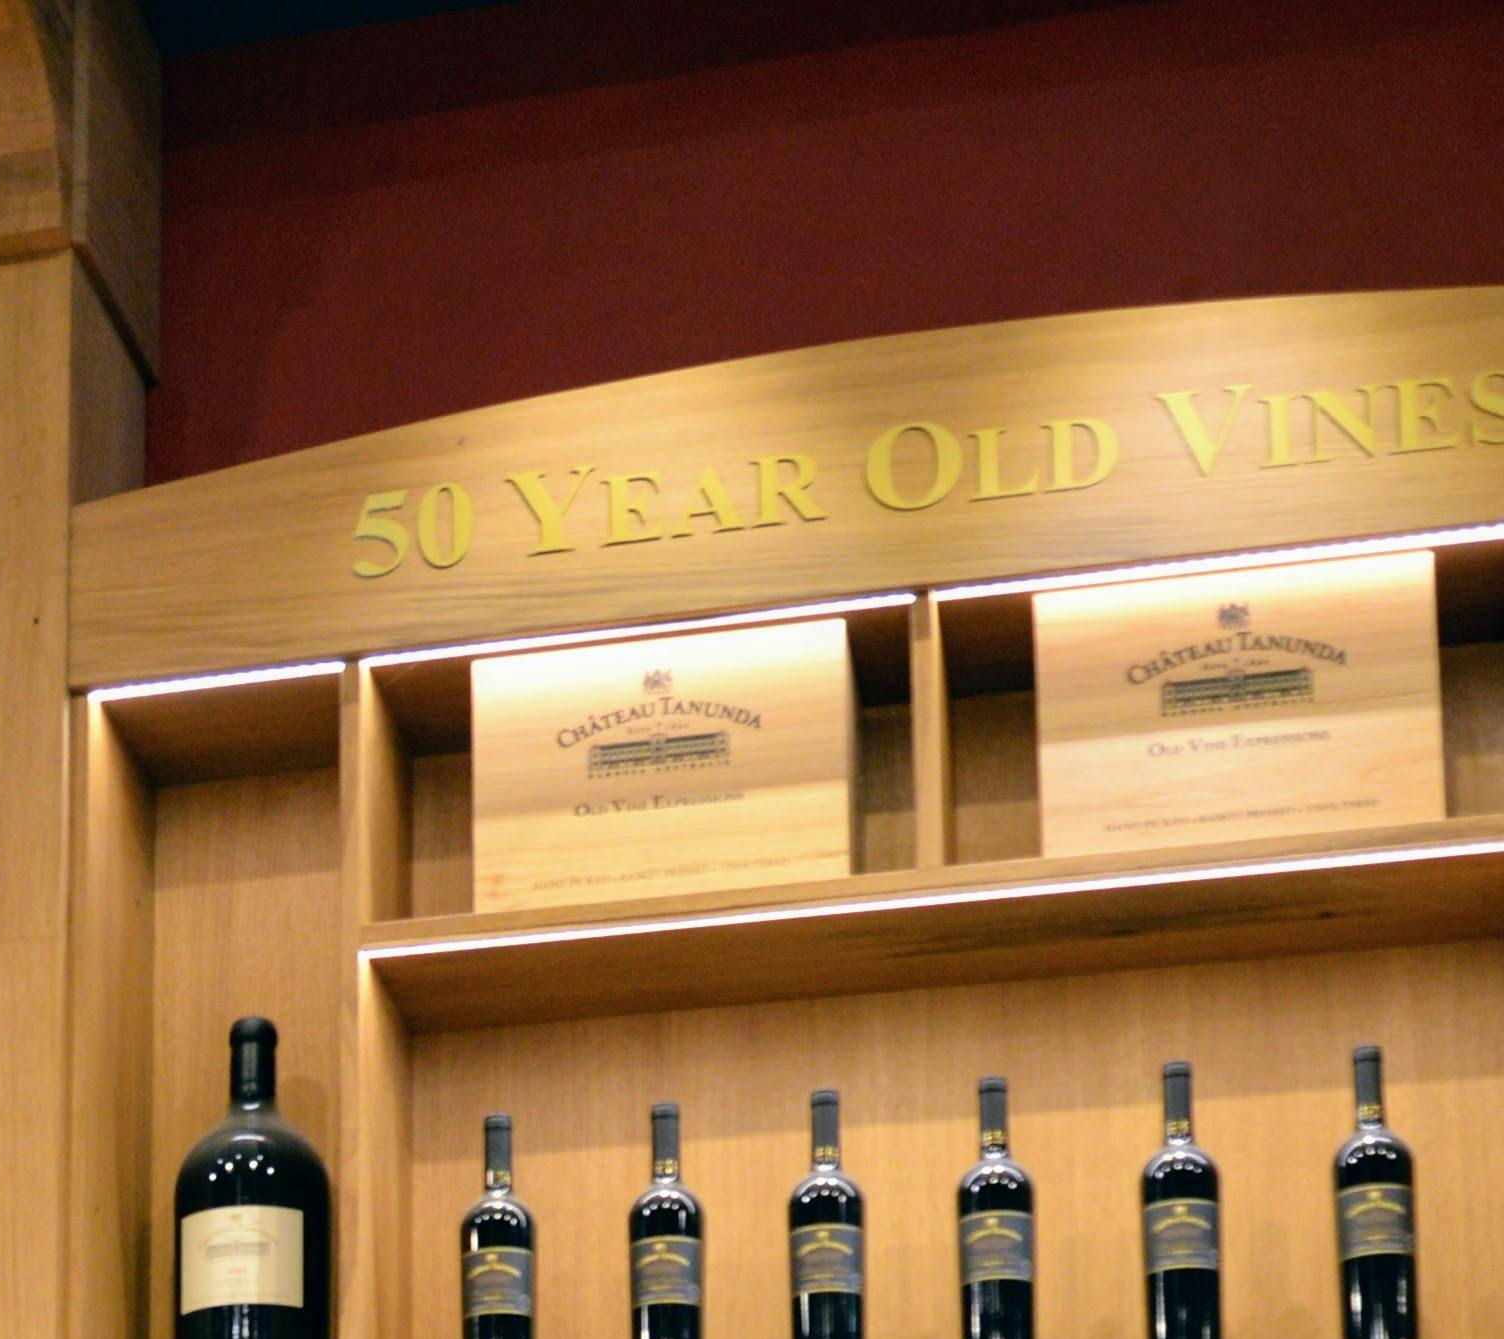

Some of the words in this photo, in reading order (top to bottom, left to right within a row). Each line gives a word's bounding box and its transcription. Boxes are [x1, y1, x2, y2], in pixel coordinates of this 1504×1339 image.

[351, 481, 475, 579] 50
[506, 450, 827, 558] YEAR
[865, 415, 1119, 513] OLD
[1126, 635, 1232, 686] CHÂTEAU
[1236, 631, 1347, 666] TANUNDA
[556, 701, 656, 749] CHÂTEAU
[659, 696, 763, 730] TANUNDA
